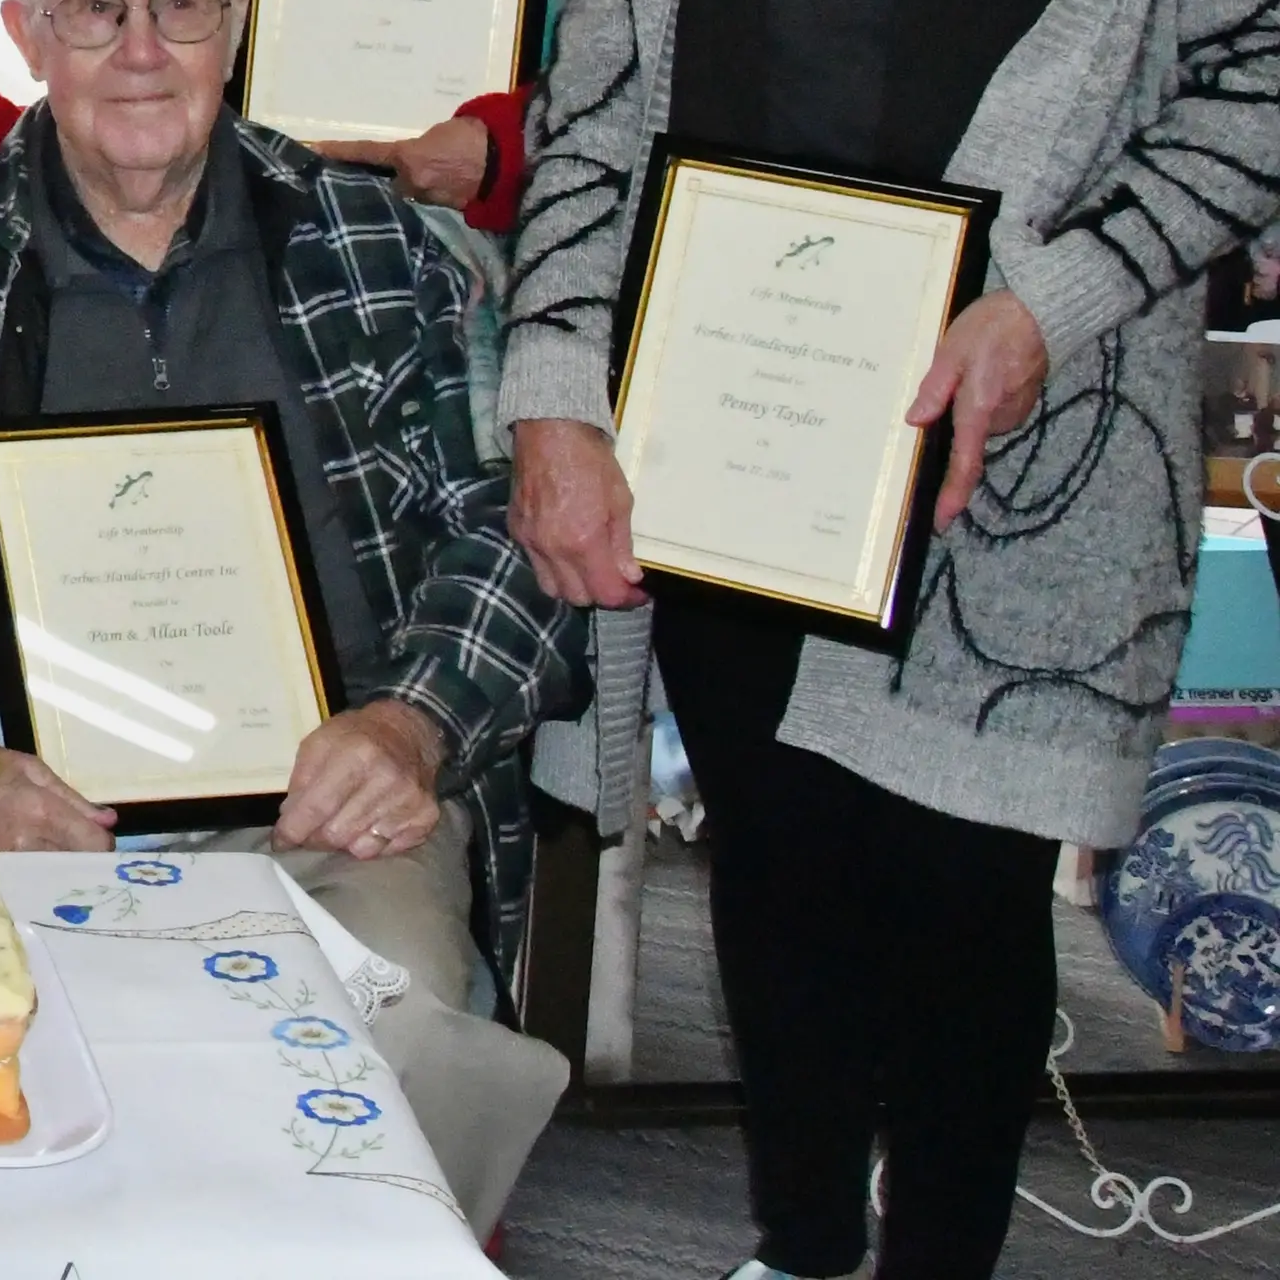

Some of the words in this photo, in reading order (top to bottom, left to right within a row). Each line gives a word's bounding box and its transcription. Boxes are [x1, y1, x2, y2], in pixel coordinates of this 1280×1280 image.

[777, 291, 842, 315] Membership
[692, 323, 736, 342] Forbes
[738, 332, 809, 359] Handicraft
[812, 348, 854, 367] Centre
[857, 357, 880, 372] Inc
[719, 392, 769, 420] Penny
[772, 404, 828, 428] Taylor
[122, 526, 184, 538] Membership
[60, 571, 101, 585] Forbes
[103, 566, 171, 584] Handicraft
[175, 566, 215, 580] Centre
[219, 565, 240, 577] Inc
[87, 628, 123, 643] Pam
[126, 629, 138, 641] &
[138, 623, 188, 642] Allan
[192, 620, 234, 638] Toole
